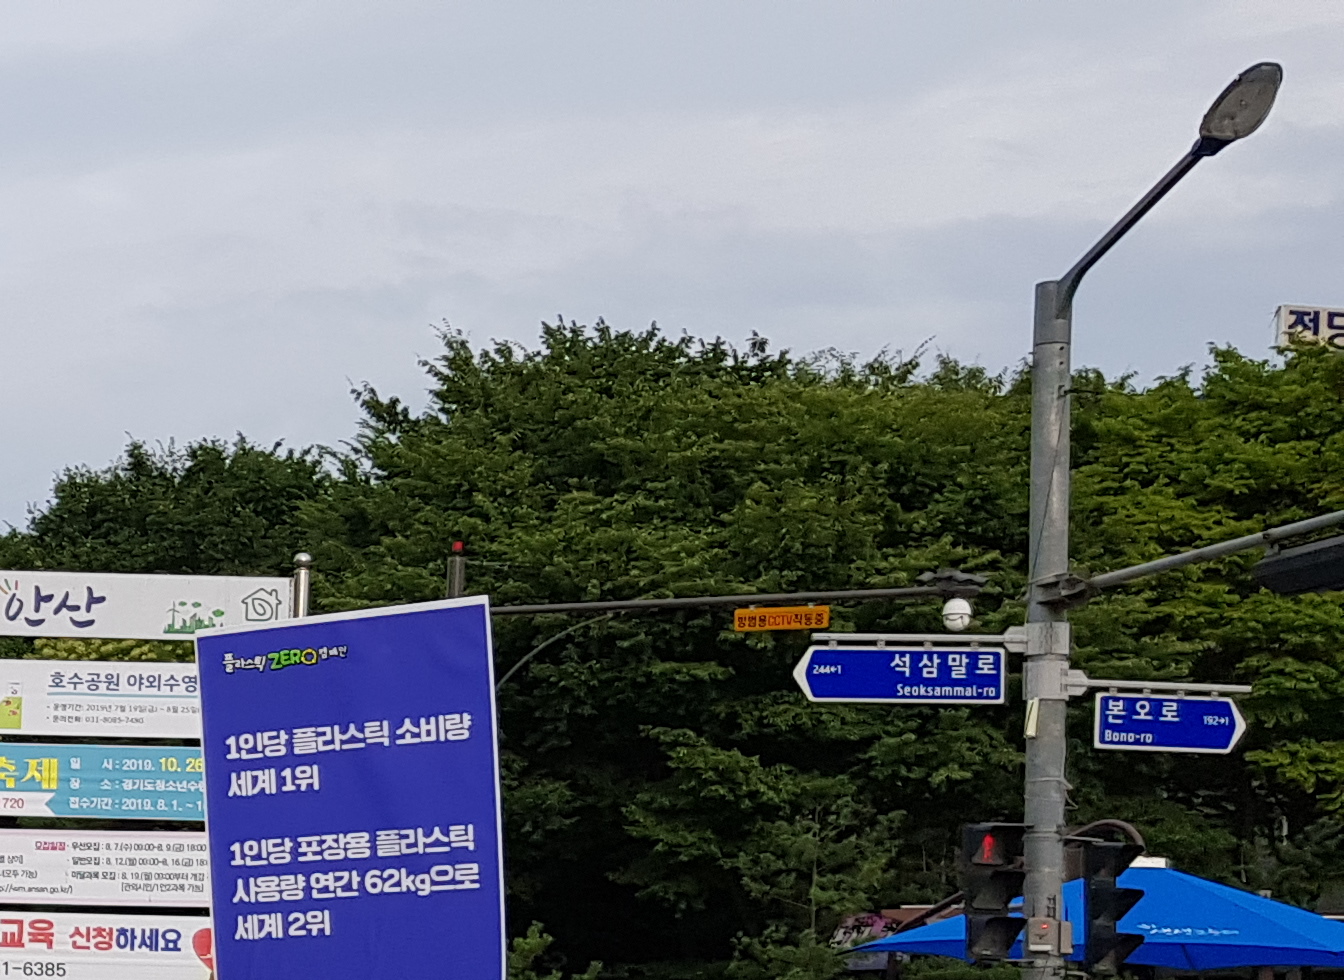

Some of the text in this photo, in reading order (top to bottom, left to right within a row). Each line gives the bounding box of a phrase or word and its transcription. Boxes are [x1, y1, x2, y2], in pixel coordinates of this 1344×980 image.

[4, 582, 106, 628] 안산
[267, 648, 317, 671] ZERO
[890, 653, 998, 679] 석삼말로
[48, 672, 120, 692] 호수공원
[896, 684, 996, 697] Seoksammal-ro
[1104, 699, 1181, 725] 본오로
[225, 712, 472, 761] 1인당 플라스틱 소비량
[1104, 729, 1153, 743] Bono-ro
[123, 758, 155, 771] 2019.
[160, 758, 181, 772] 10.
[227, 764, 320, 798] 세계 1위
[69, 797, 112, 810] 접수기간
[122, 798, 155, 810] 2019.
[229, 823, 476, 868] 1인당 포장용 플라스틱
[232, 862, 481, 906] 사용량 연간 62kg으로
[234, 908, 332, 941] 세계 2위
[68, 924, 183, 952] 신청하세요
